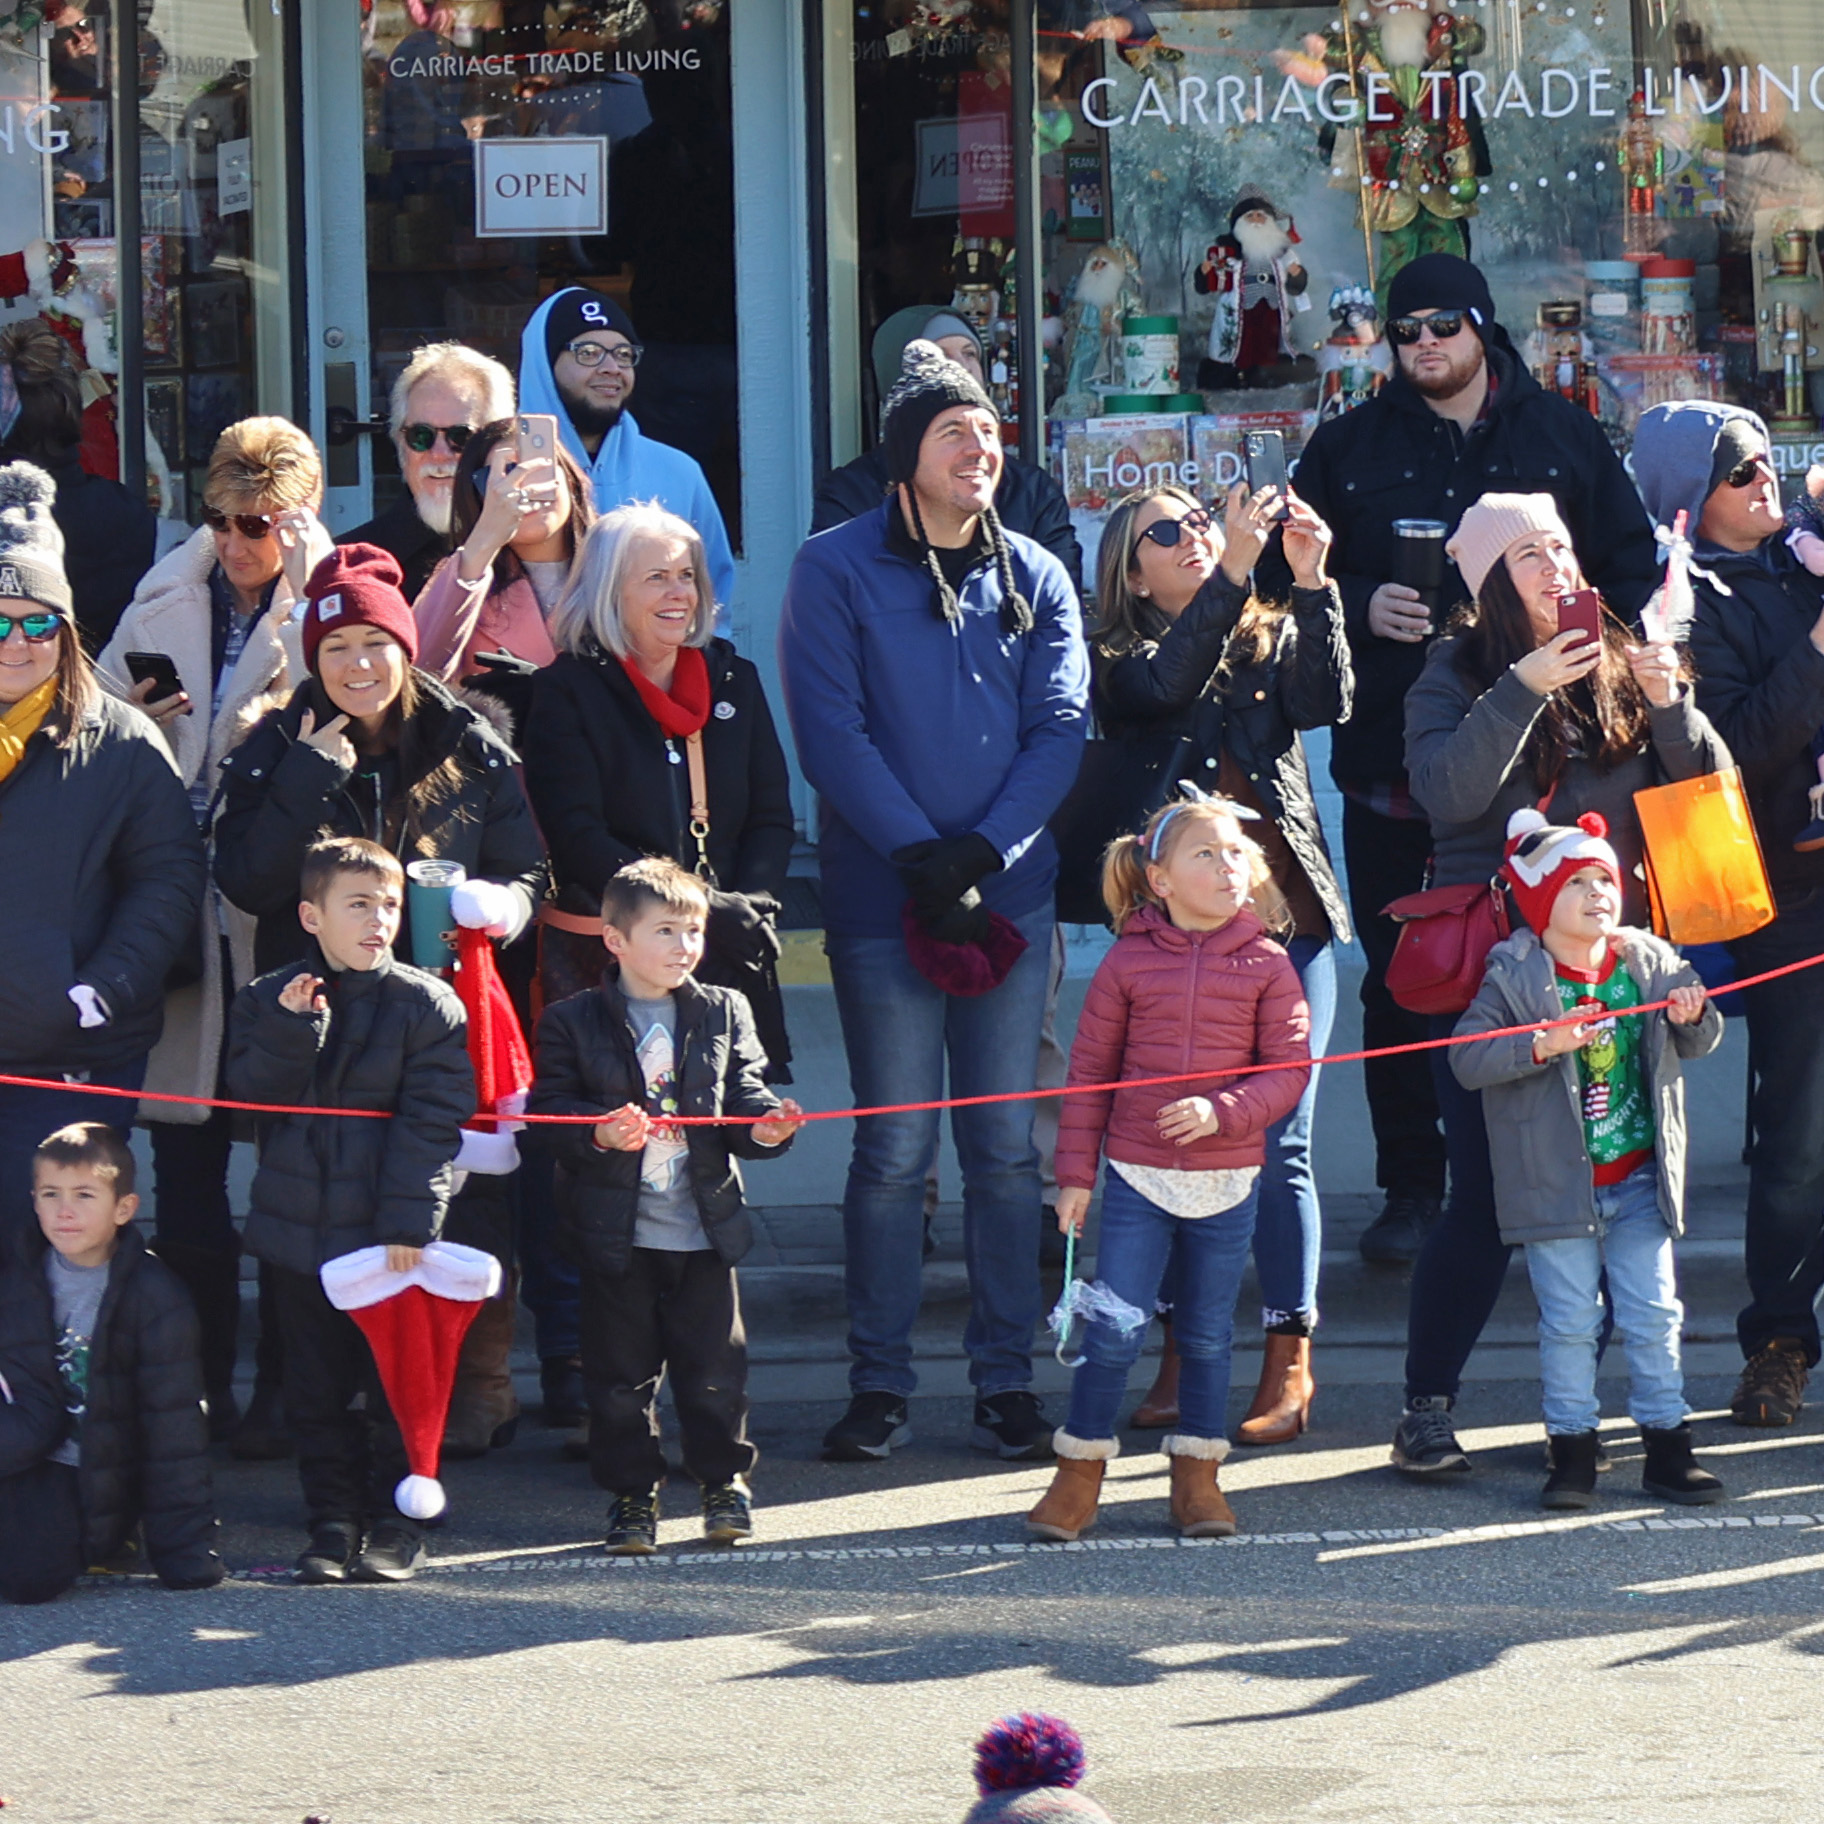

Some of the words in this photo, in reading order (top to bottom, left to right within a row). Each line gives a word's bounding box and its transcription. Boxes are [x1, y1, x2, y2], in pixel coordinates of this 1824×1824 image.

[390, 53, 516, 78] CARRIAGE
[525, 50, 604, 75] TRADE
[615, 47, 701, 72] LIVING
[1081, 72, 1395, 128] CARRIAGE
[1420, 69, 1615, 119] TRADE
[494, 172, 587, 199] OPEN
[1085, 454, 1200, 488] Home
[1593, 1087, 1641, 1138] NAUGHTY
